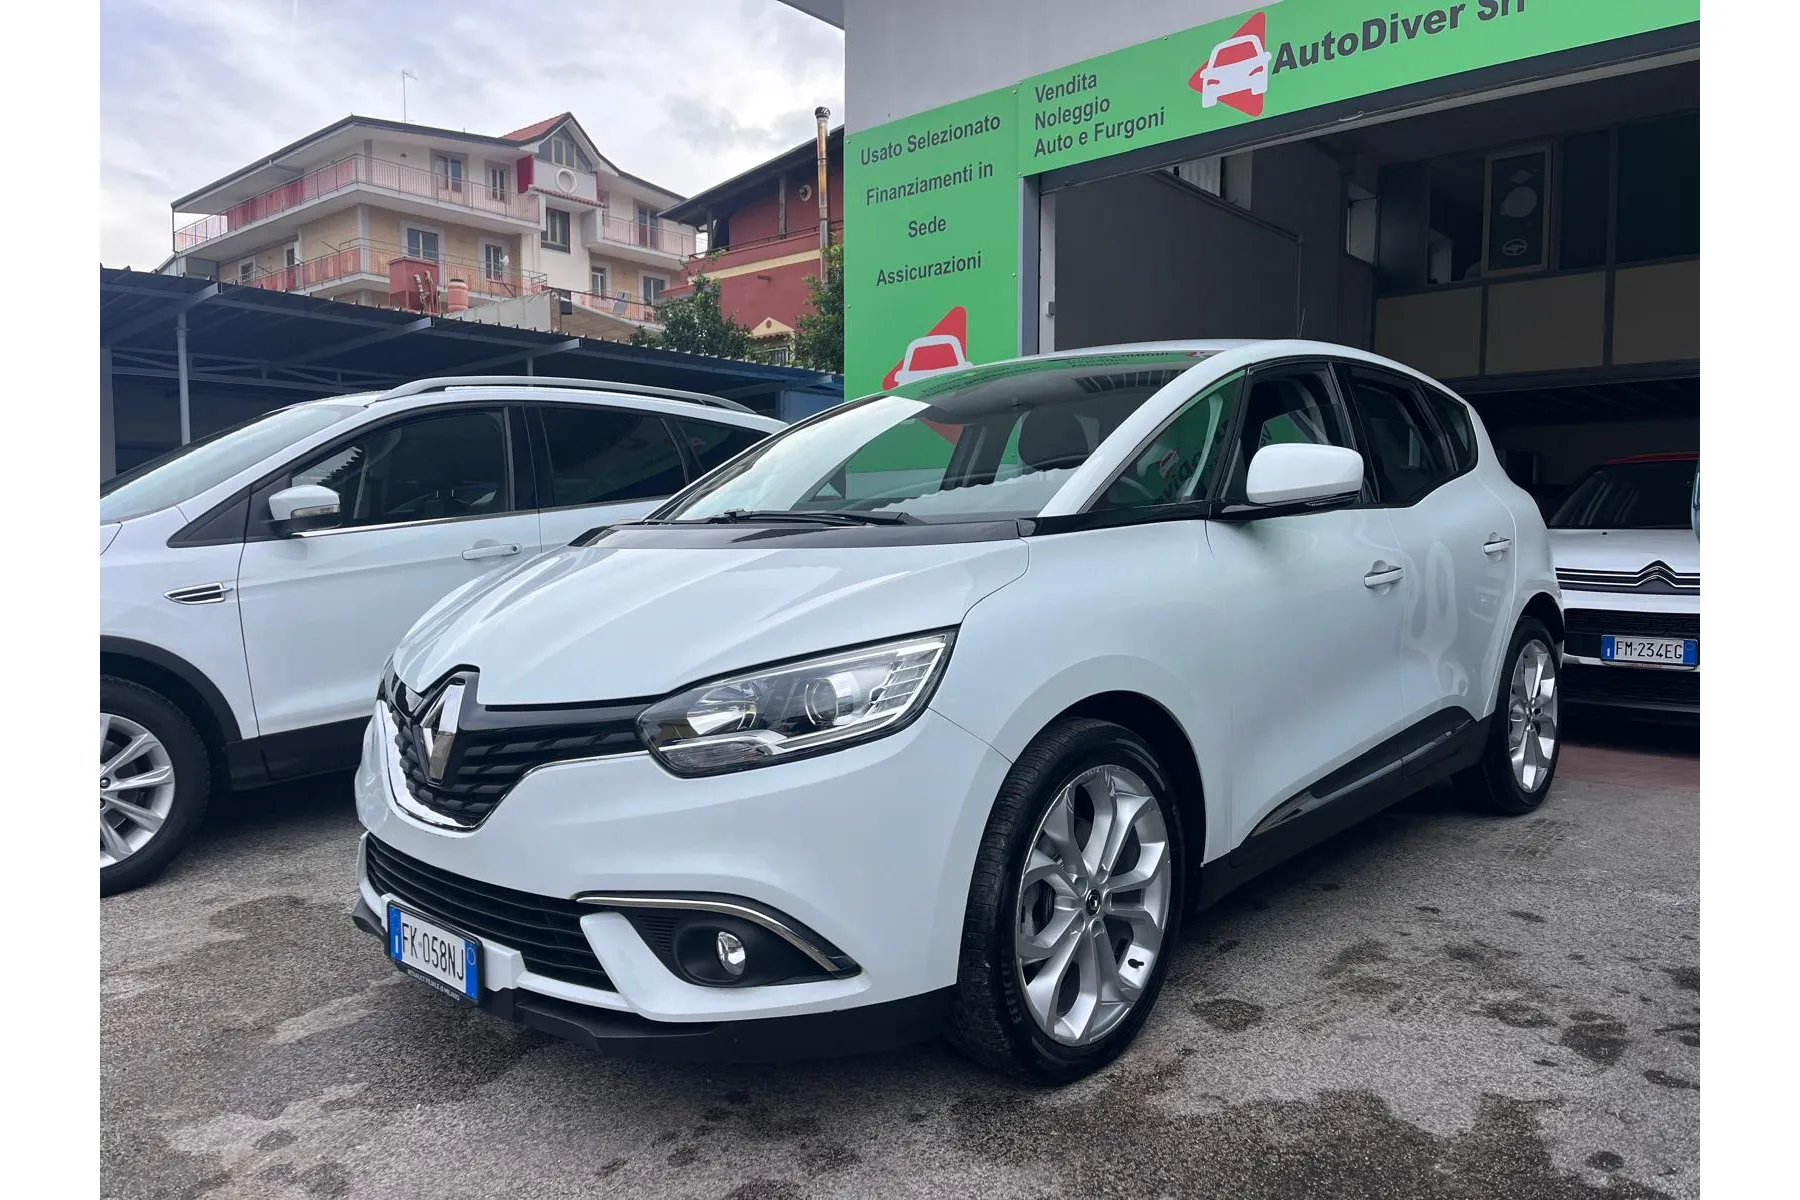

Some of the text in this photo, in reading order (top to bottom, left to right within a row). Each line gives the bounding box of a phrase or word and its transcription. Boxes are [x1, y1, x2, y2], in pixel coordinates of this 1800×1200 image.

[1272, 3, 1466, 74] AutoDiver
[1034, 73, 1098, 104] Vendita
[1033, 106, 1166, 158] Auto e Furgoni
[1034, 96, 1111, 131] Noleggio
[860, 114, 1001, 166] Usato Selezionato
[866, 160, 993, 206] Finanziamenti in
[907, 216, 947, 239] Sede
[875, 250, 982, 287] Assicurazioni
